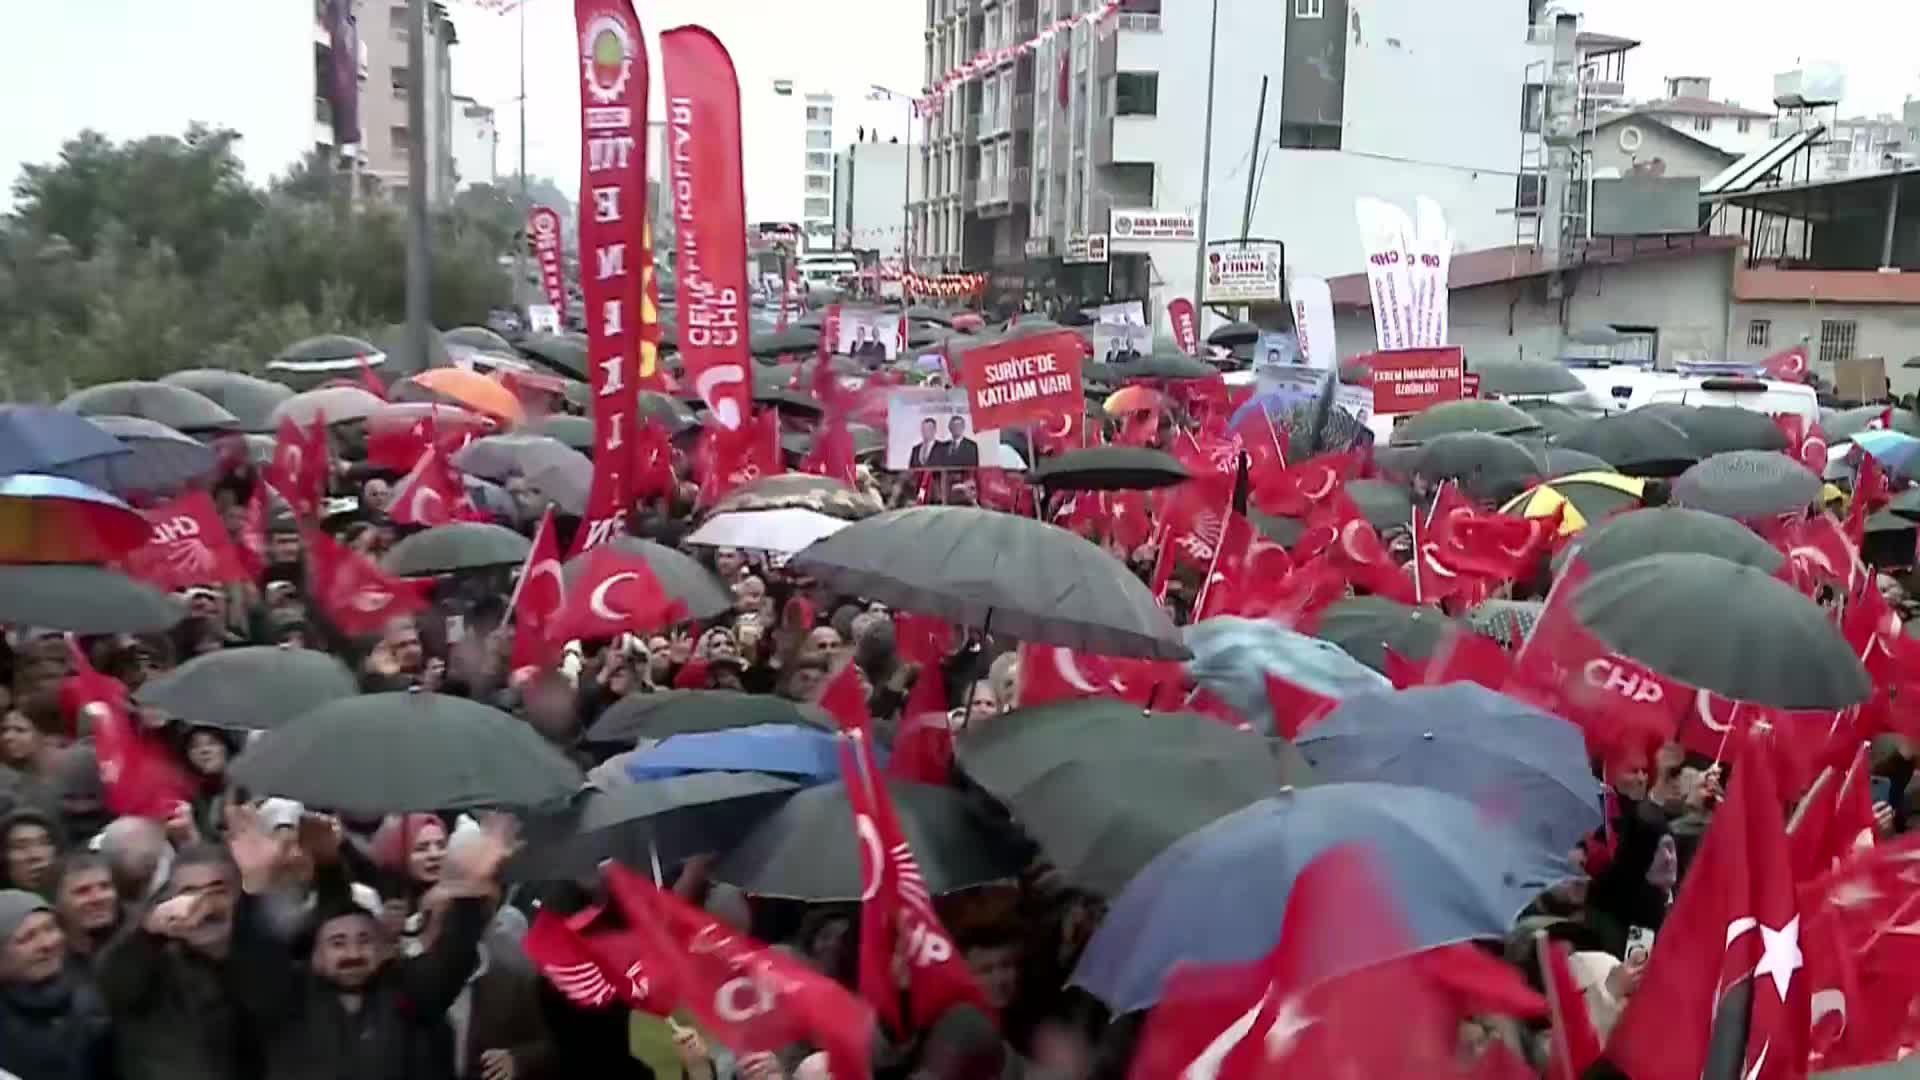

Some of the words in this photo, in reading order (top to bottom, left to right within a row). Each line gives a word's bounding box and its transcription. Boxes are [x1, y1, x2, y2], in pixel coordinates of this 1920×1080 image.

[984, 353, 1057, 383] SURİYE'DE
[977, 380, 1037, 408] KATLİAM
[1583, 658, 1664, 702] CHP
